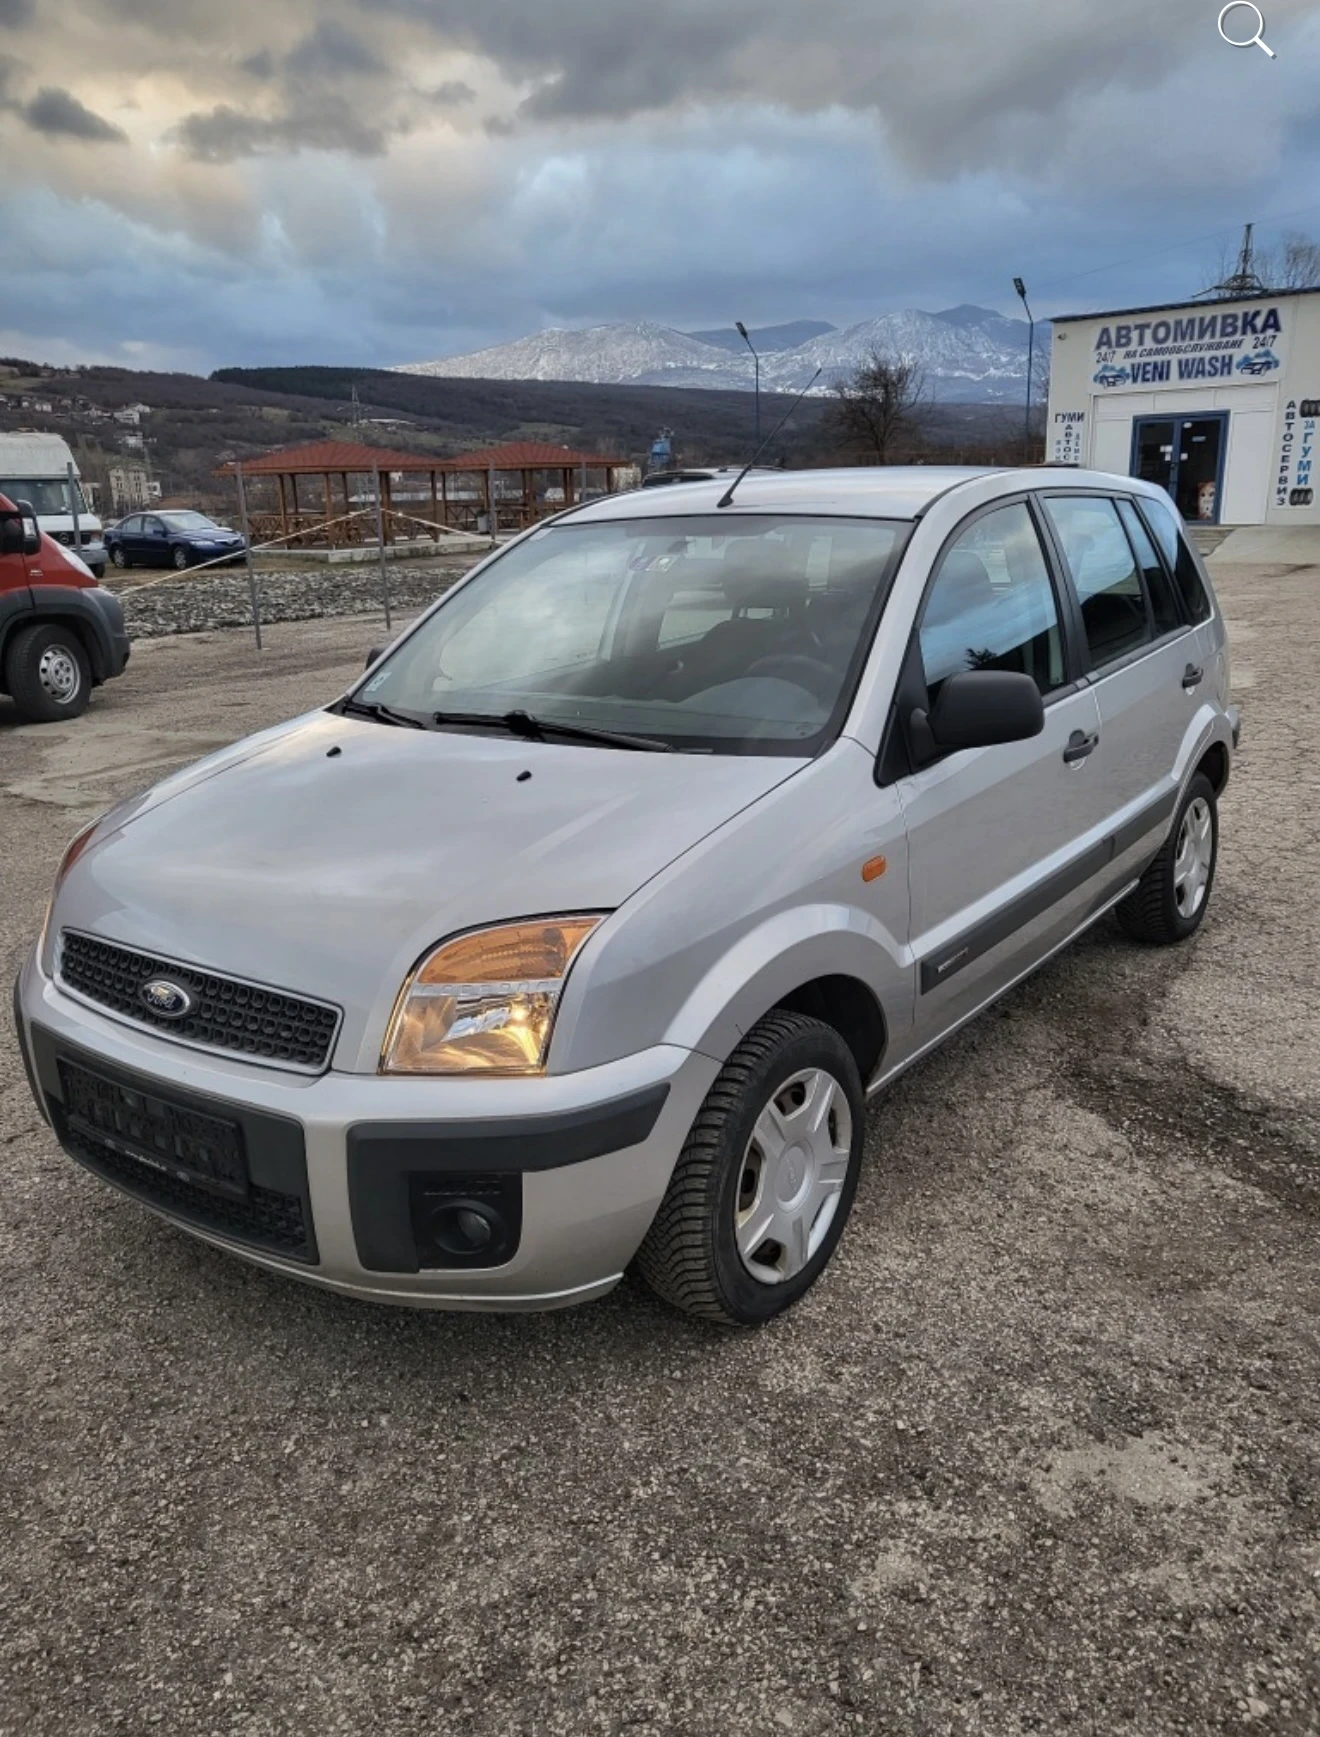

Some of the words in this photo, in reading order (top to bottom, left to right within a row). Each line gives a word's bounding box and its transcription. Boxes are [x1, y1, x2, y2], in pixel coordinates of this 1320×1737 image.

[1094, 307, 1282, 350] АВТОМИВКА
[1096, 350, 1116, 363] 24/7
[1123, 350, 1137, 359] НА
[1252, 335, 1277, 349] 24/7
[1130, 359, 1171, 384] VENI
[1177, 354, 1233, 381] WASH
[1055, 412, 1085, 423] ГУМИ
[1276, 400, 1296, 506] АВТОСЕРВИЗ
[1297, 432, 1313, 486] ГУМИ
[147, 990, 177, 1009] Ford
